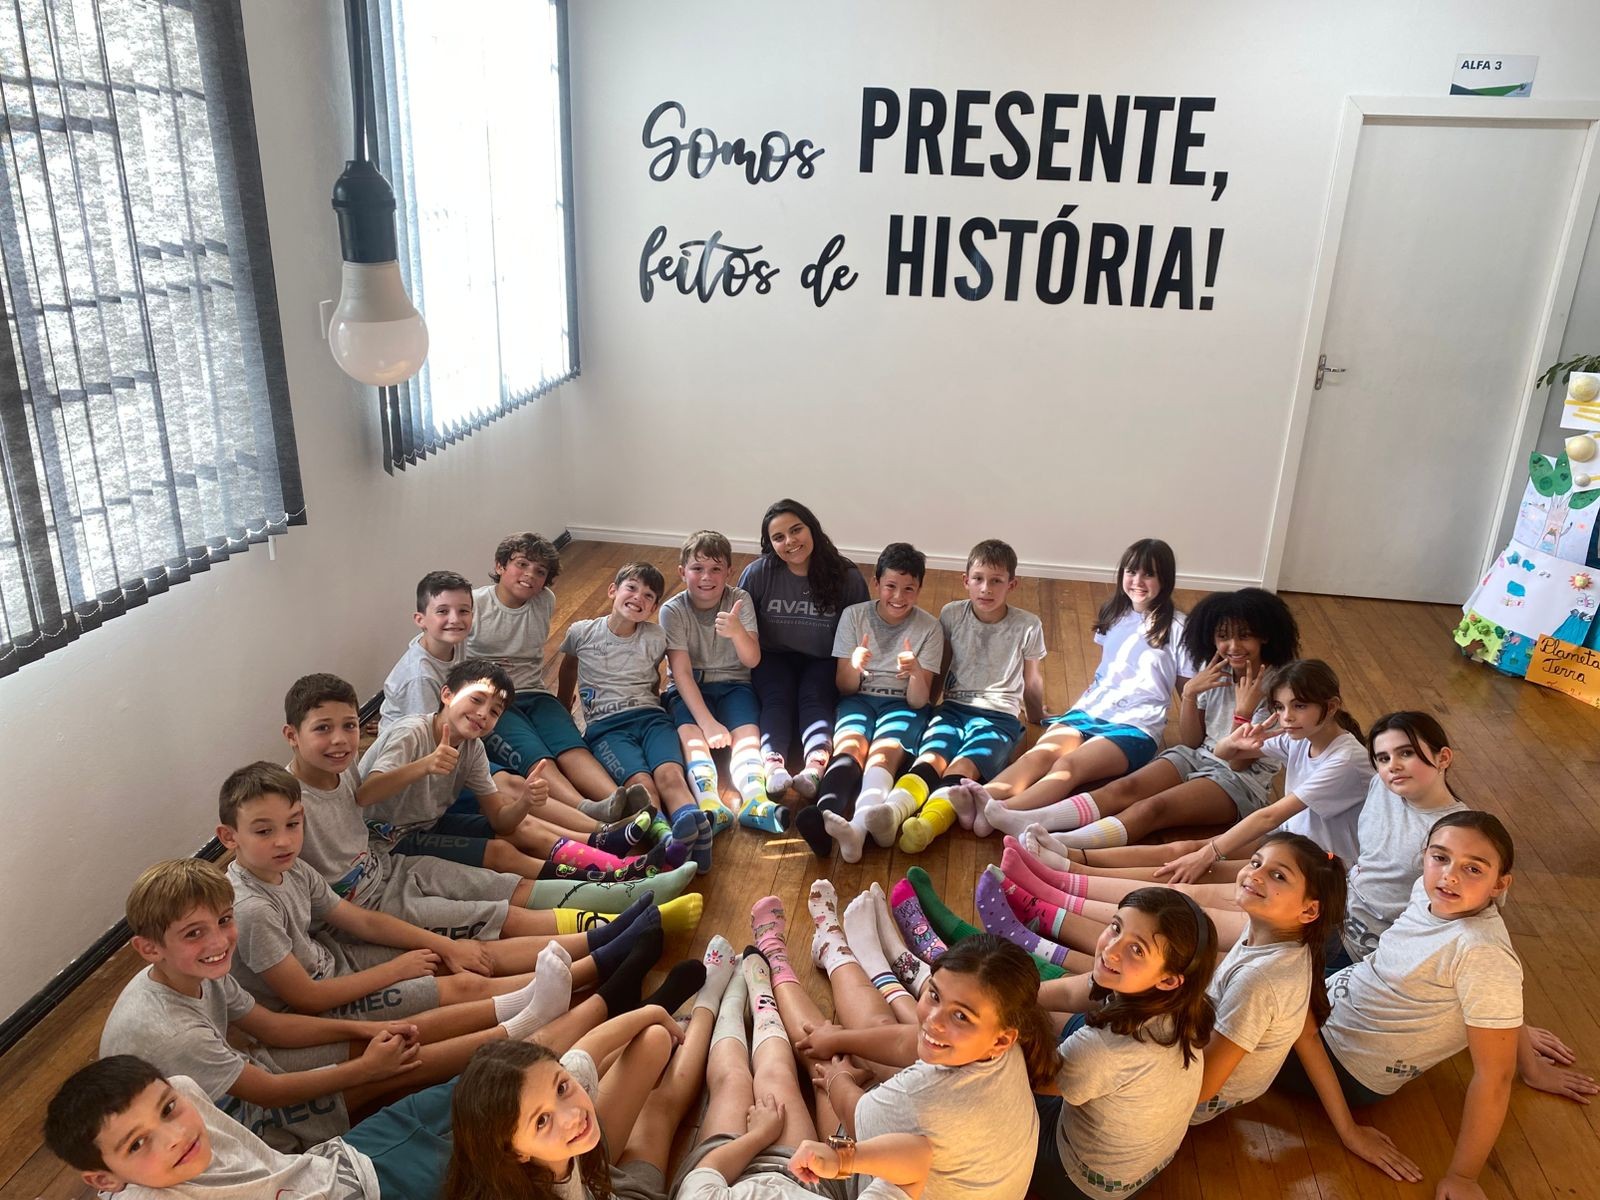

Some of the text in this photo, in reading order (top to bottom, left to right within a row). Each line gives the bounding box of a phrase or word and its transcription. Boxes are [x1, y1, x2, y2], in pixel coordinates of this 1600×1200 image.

[1461, 60, 1502, 70] ALFA 3
[643, 87, 1228, 201] Somos PRESENTE,
[640, 205, 1224, 310] feitos de HISTÓRIA!
[1540, 637, 1600, 669] Planeta
[1543, 658, 1585, 684] Terra
[598, 741, 625, 778] AVAEC
